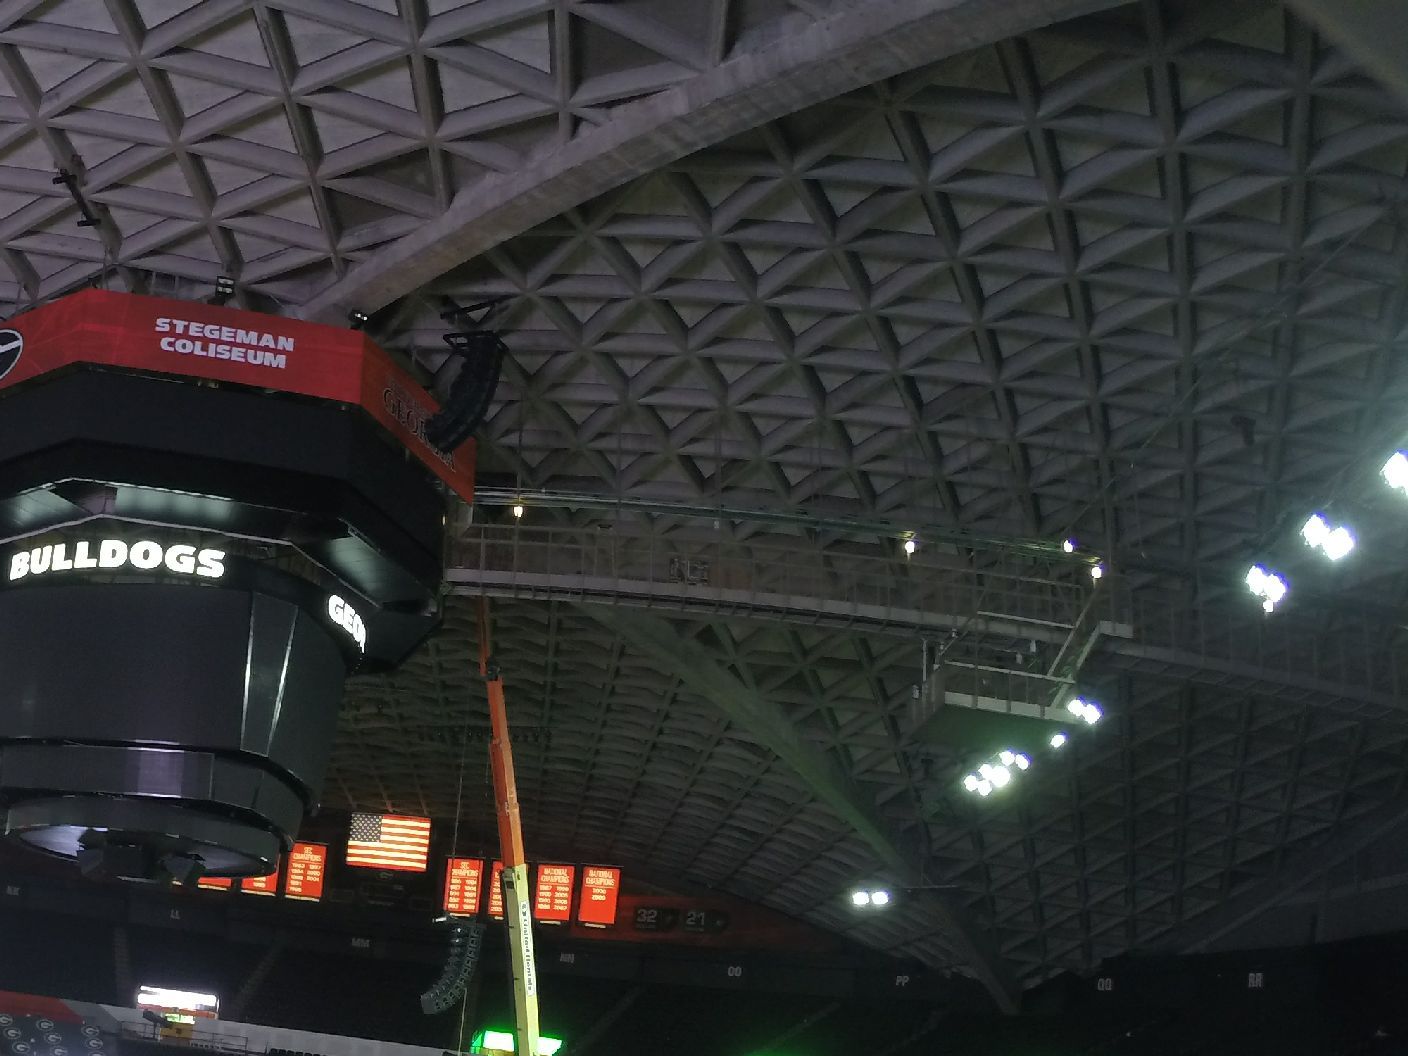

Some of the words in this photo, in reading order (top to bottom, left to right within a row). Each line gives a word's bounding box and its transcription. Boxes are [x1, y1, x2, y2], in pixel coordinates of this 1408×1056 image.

[155, 317, 295, 352] STEGEMAN
[160, 337, 287, 369] COLISEUM
[8, 539, 226, 581] BULLDOGS
[585, 877, 615, 886] CHAMPIONS
[686, 911, 705, 926] 21
[895, 975, 910, 987] PP
